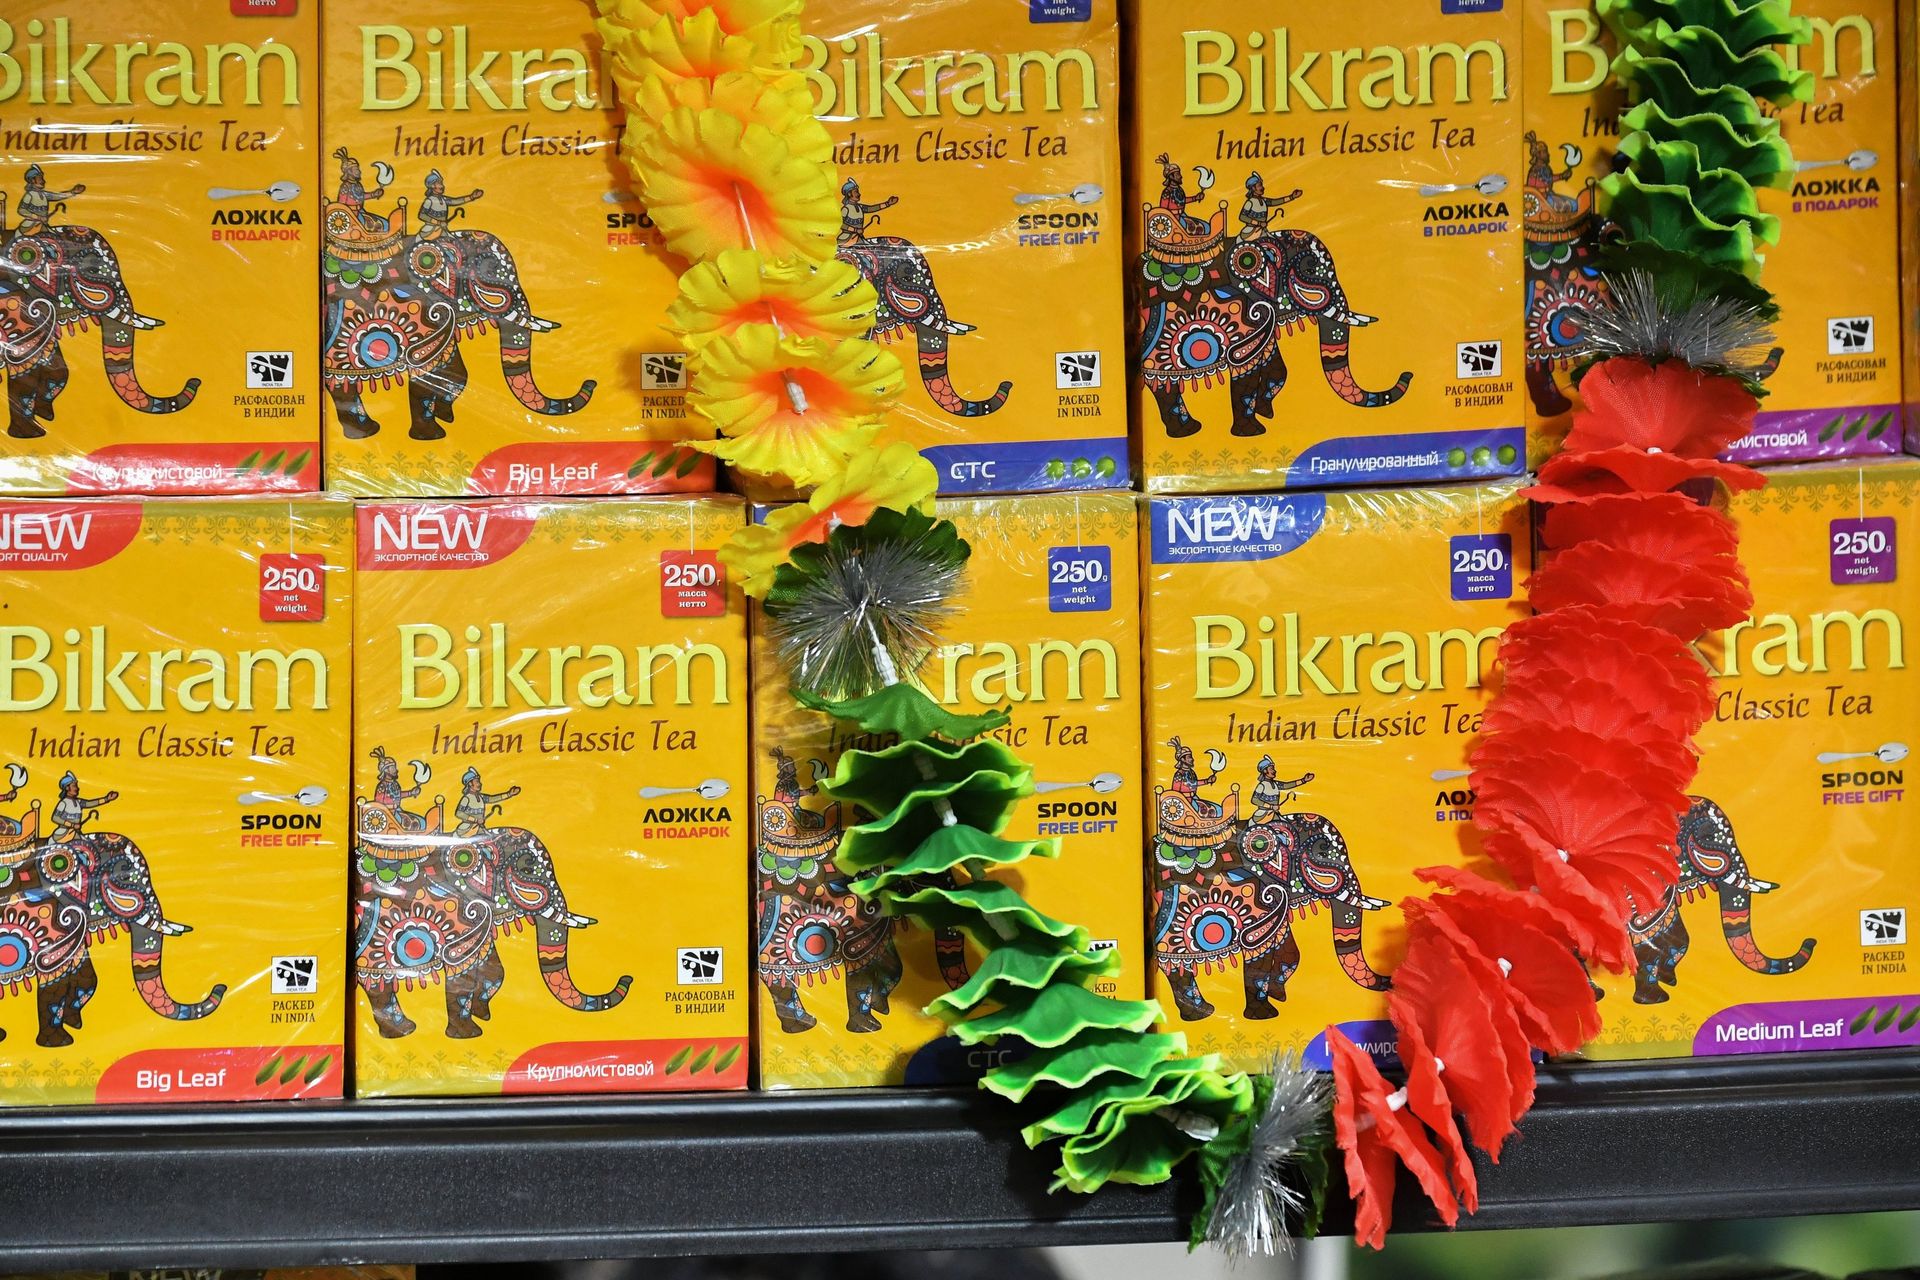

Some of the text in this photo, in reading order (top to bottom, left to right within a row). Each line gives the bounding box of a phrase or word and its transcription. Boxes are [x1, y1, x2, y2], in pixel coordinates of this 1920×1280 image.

[1043, 6, 1076, 16] weight
[1181, 26, 1508, 116] Bikram
[0, 116, 268, 152] ndian Classic Tea
[393, 123, 484, 157] Indian
[501, 121, 598, 157] Classic
[1215, 118, 1476, 161] Indian Classic Tea
[832, 125, 1068, 165] dian Classic Tea
[1791, 177, 1881, 198] ЛОЖКА
[1422, 201, 1510, 222] ЛОЖКА
[1792, 196, 1879, 213] В ПОДАРОК
[211, 209, 303, 225] ЛОЖКА
[606, 212, 654, 229] SPO
[1017, 211, 1099, 230] SPOON
[211, 229, 301, 241] В ПОДАРОК
[1423, 221, 1508, 237] В ПОДАРОК
[607, 231, 648, 246] FREE
[1018, 230, 1101, 247] FREE GIFT
[1816, 357, 1887, 372] РАСФАСОВАН
[1826, 371, 1877, 384] В ИНДИИ
[1444, 381, 1514, 396] РАСФАСОВАН
[233, 394, 305, 406] РАСФАСОВАН
[642, 395, 685, 406] PACKED
[1058, 394, 1100, 406] PACKED
[1454, 395, 1504, 408] В ИНДИИ
[243, 407, 296, 418] В ИНДИИ
[641, 408, 687, 419] IN INDIA
[1057, 406, 1102, 418] IN INDIA
[950, 460, 996, 480] CTC
[1311, 450, 1439, 474] Гранулированный
[508, 462, 599, 484] Big Leaf
[0, 512, 93, 551] EW
[374, 511, 489, 550] NEW
[1167, 505, 1279, 543] NEW
[22, 552, 69, 562] QUALITY
[374, 552, 490, 562] ЭКСПОРТНОЕ КАЧЕСТВО
[1168, 543, 1282, 555] ЭКСПОРТНОЕ КАЧЕСТВО
[1854, 556, 1870, 564] net
[1467, 575, 1496, 583] масса
[1845, 566, 1880, 576] weight
[678, 590, 708, 598] масса
[1071, 585, 1087, 593] net
[1467, 585, 1495, 593] нетто
[283, 593, 299, 602] net
[1063, 595, 1096, 605] weight
[274, 604, 308, 614] weight
[1700, 608, 1905, 678] ram
[0, 624, 329, 713] Bikram
[396, 622, 731, 710] Bikram
[1716, 685, 1873, 722] Classic Tea
[1042, 715, 1089, 747] Tea
[1226, 710, 1317, 744] Indian
[1332, 705, 1427, 740] Classic
[27, 722, 296, 760] Indian Classic Tea
[431, 718, 698, 756] Indian Classic Tea
[1821, 769, 1904, 789] SPOON
[1822, 788, 1905, 806] FREE GIFT
[642, 807, 732, 823] ЛОЖКА
[1037, 800, 1118, 819] SPOON
[1436, 810, 1446, 822] В
[241, 813, 322, 830] SPOON
[1038, 820, 1118, 836] FREE GIFT
[240, 832, 323, 848] FREE GIFT
[643, 825, 730, 839] В ПОДАРОК
[1863, 950, 1905, 963] PACKED
[1861, 963, 1907, 975] IN INDIA
[665, 990, 735, 1002] РАСФАСОВАН
[272, 1000, 315, 1011] PACKED
[675, 1003, 726, 1015] В ИНДИИ
[271, 1012, 316, 1024] IN INDIA
[1715, 1018, 1844, 1043] Medium Leaf
[527, 1060, 654, 1082] Крупнолистовой
[136, 1068, 227, 1092] Big Leaf
